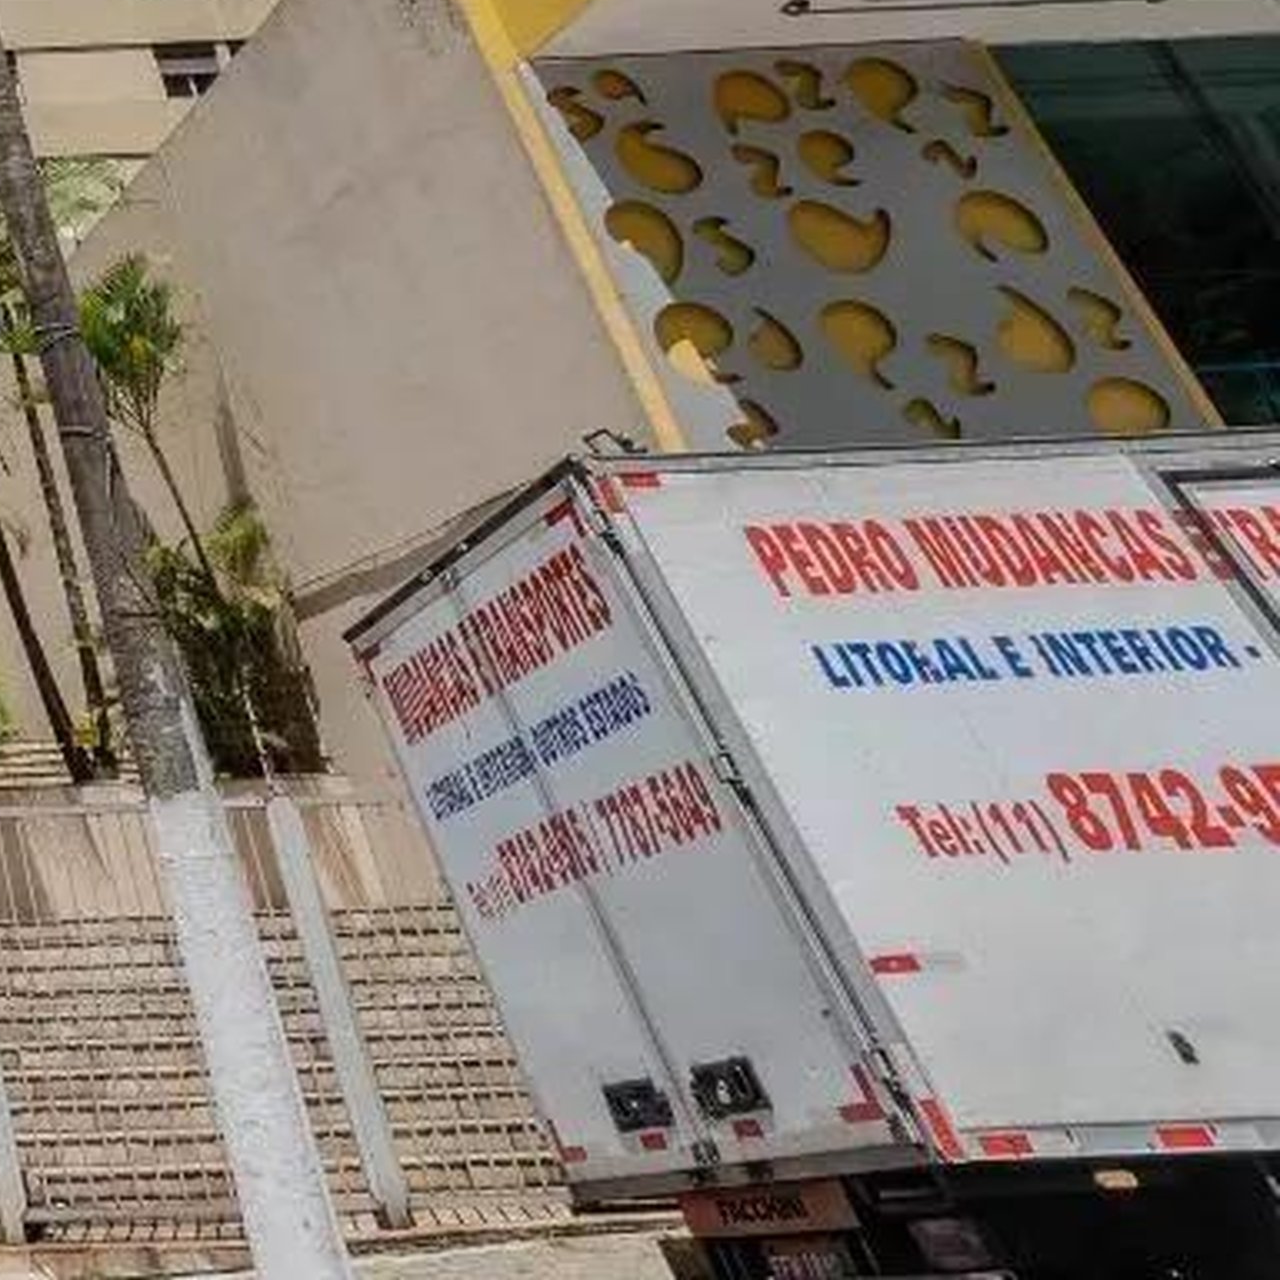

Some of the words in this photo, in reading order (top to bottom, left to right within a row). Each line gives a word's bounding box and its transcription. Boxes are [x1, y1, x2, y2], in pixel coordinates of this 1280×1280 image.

[744, 519, 919, 596] PEDRO
[903, 510, 1197, 588] MUDANCAS
[993, 636, 1034, 679] E
[1030, 626, 1243, 679] INTERIOR
